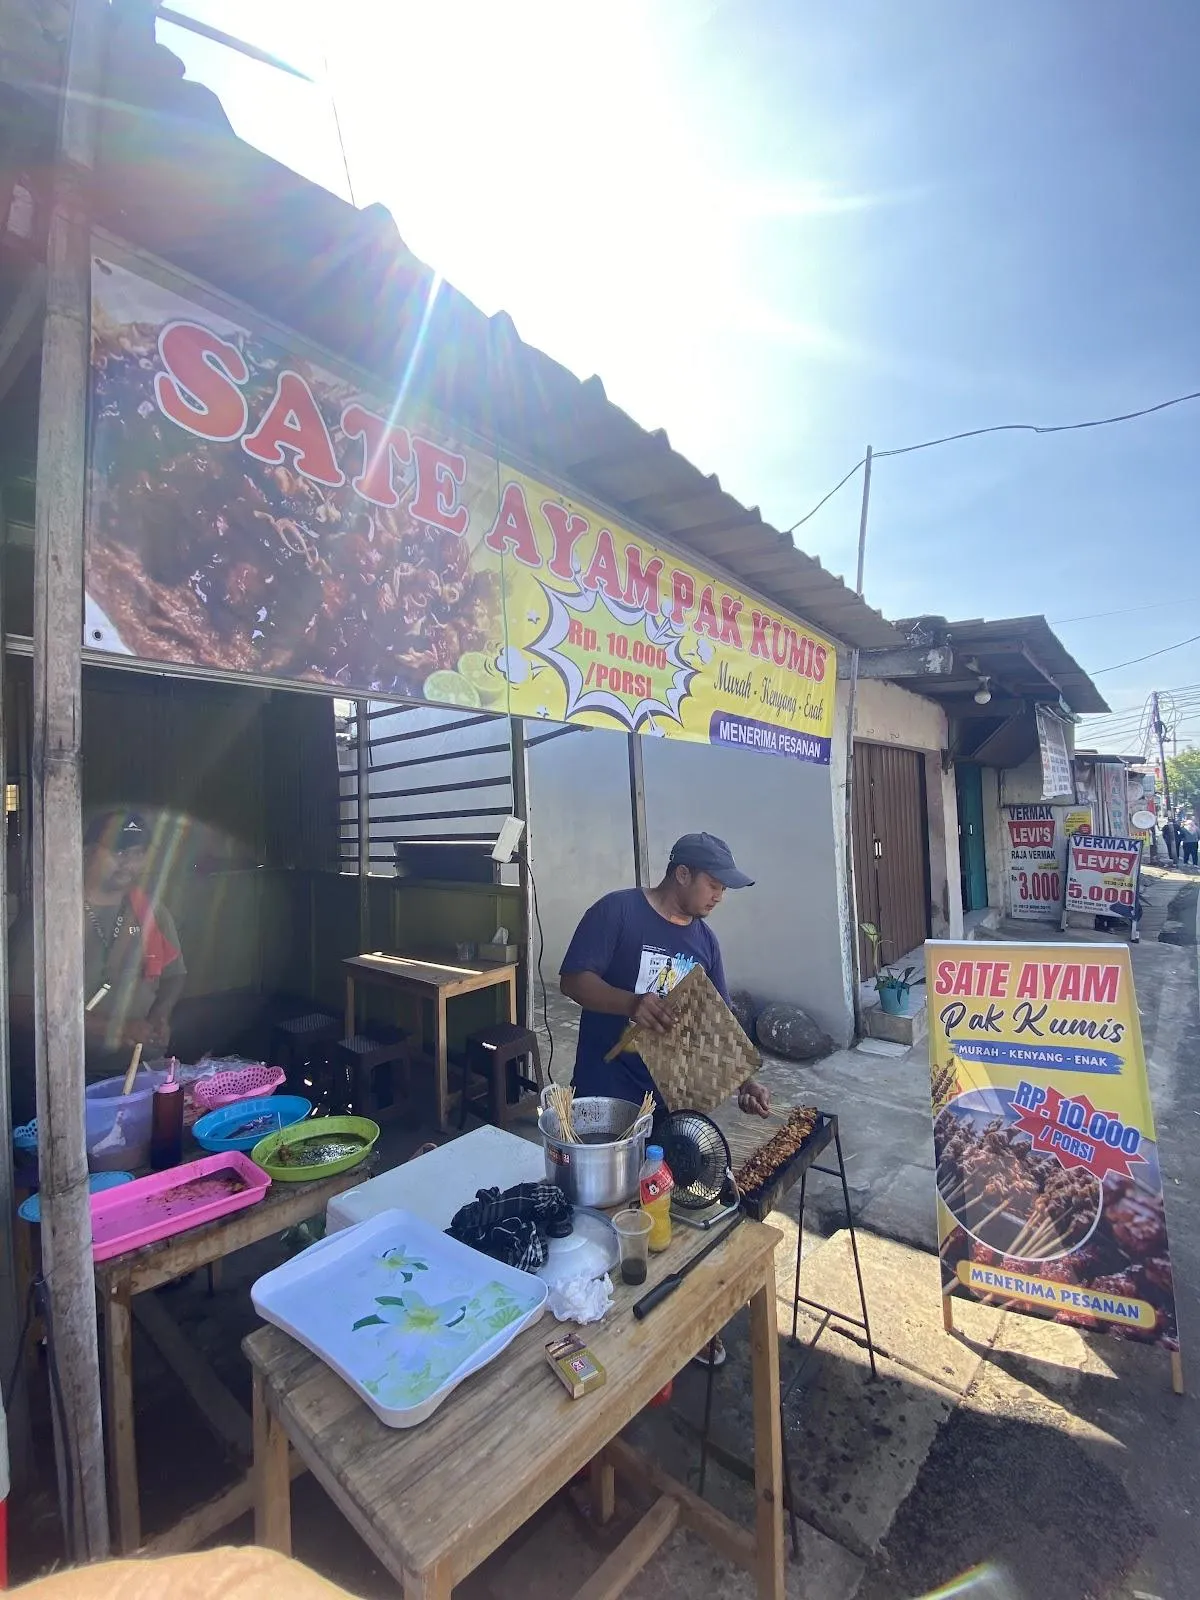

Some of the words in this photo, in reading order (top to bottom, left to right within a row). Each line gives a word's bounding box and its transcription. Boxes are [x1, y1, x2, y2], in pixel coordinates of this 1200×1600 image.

[154, 320, 469, 537] SATE
[484, 482, 665, 617] AYAM
[669, 569, 744, 651] PAK
[750, 610, 828, 684] KUMIS
[568, 618, 600, 653] Rp.
[607, 632, 667, 671] 10.000
[584, 661, 653, 700] /PORSI
[714, 660, 752, 699] Murah
[759, 676, 797, 721] Kenyang
[804, 694, 823, 721] Enak
[719, 720, 777, 750] MENERIMA
[778, 734, 821, 758] PESANAN
[1009, 806, 1053, 820] VERMAK
[1012, 826, 1051, 843] LEVI'S
[1073, 835, 1140, 852] VERMAK
[1011, 850, 1027, 860] RAJA
[1029, 850, 1056, 860] VERMAK
[1077, 853, 1130, 871] LEVI'S
[1019, 871, 1060, 902] 3.000
[1068, 883, 1134, 905] 5.000
[935, 959, 1008, 999] SATE
[1016, 961, 1120, 1005] AYAM
[939, 1001, 1004, 1038] Pak
[1012, 1001, 1126, 1044] Kumis
[958, 1044, 1000, 1058] MURAH
[1009, 1049, 1063, 1064] KENYANG
[1074, 1054, 1108, 1068] ENAK
[1013, 1081, 1049, 1117] RP.
[1056, 1098, 1141, 1156] 10.000
[1051, 1129, 1096, 1163] PORSI
[970, 1267, 1057, 1302] MENERIMA
[1060, 1289, 1140, 1320] PESANAN
